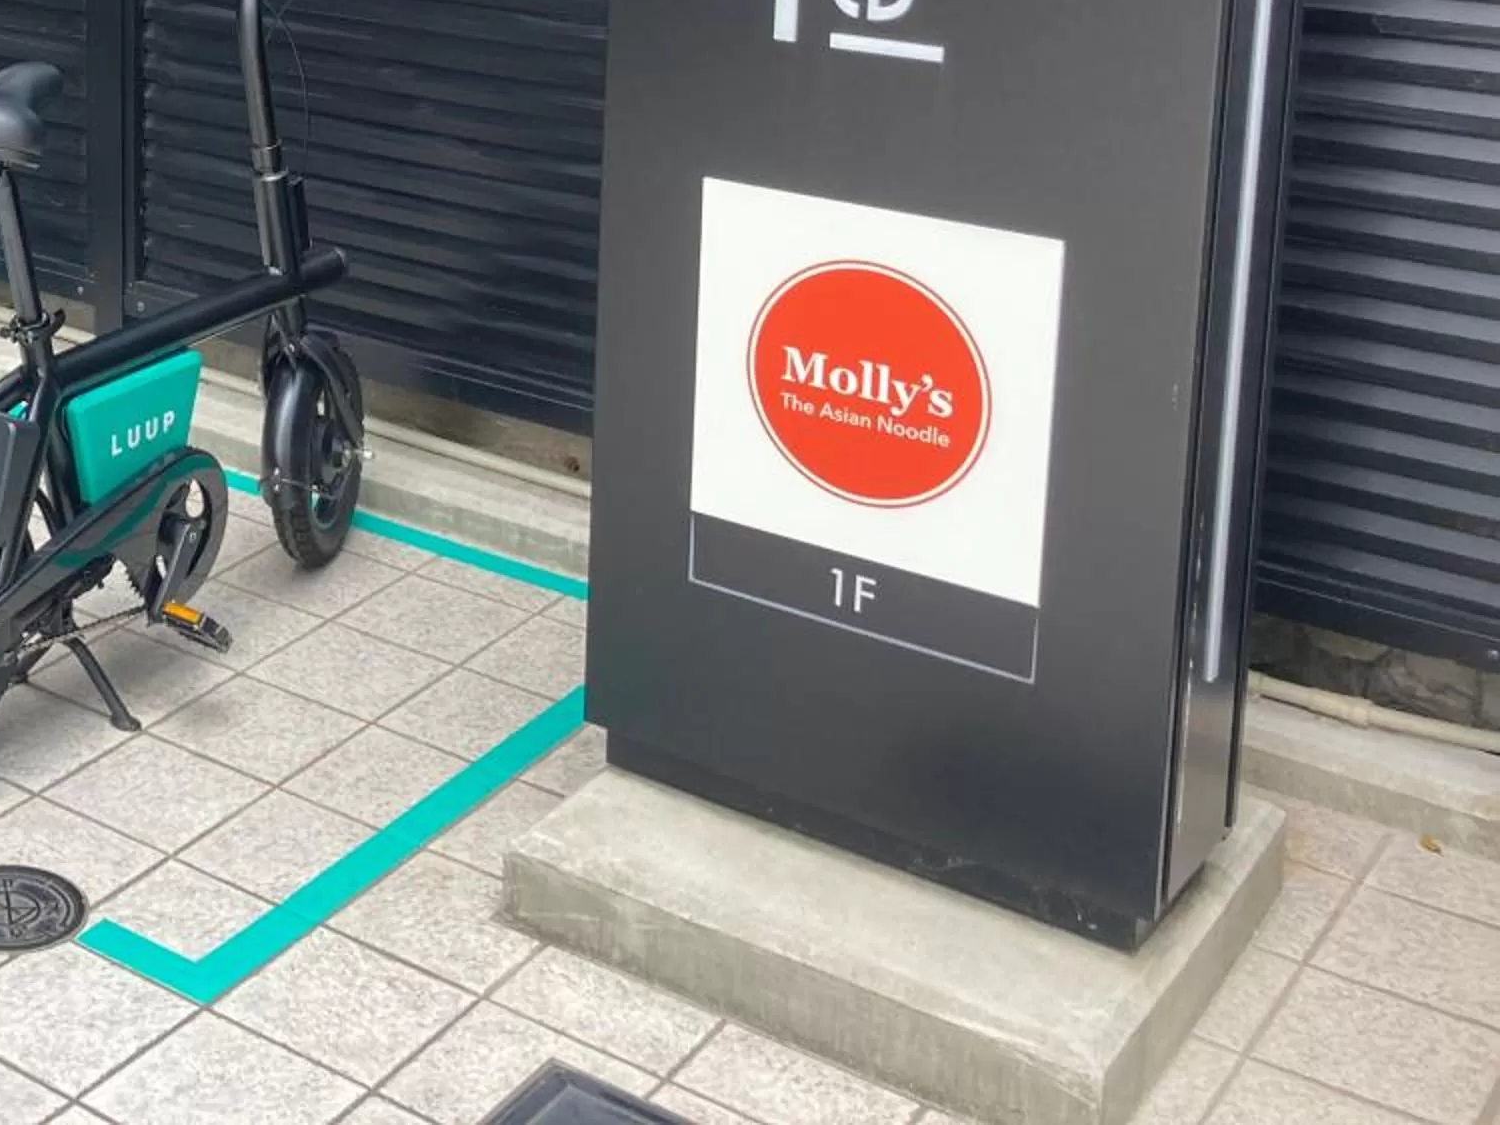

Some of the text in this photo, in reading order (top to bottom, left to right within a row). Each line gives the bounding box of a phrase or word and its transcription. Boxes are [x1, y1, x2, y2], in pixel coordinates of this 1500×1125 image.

[111, 410, 175, 459] LUUP
[780, 392, 951, 448] The Asian Noodle
[829, 568, 877, 612] 1F
